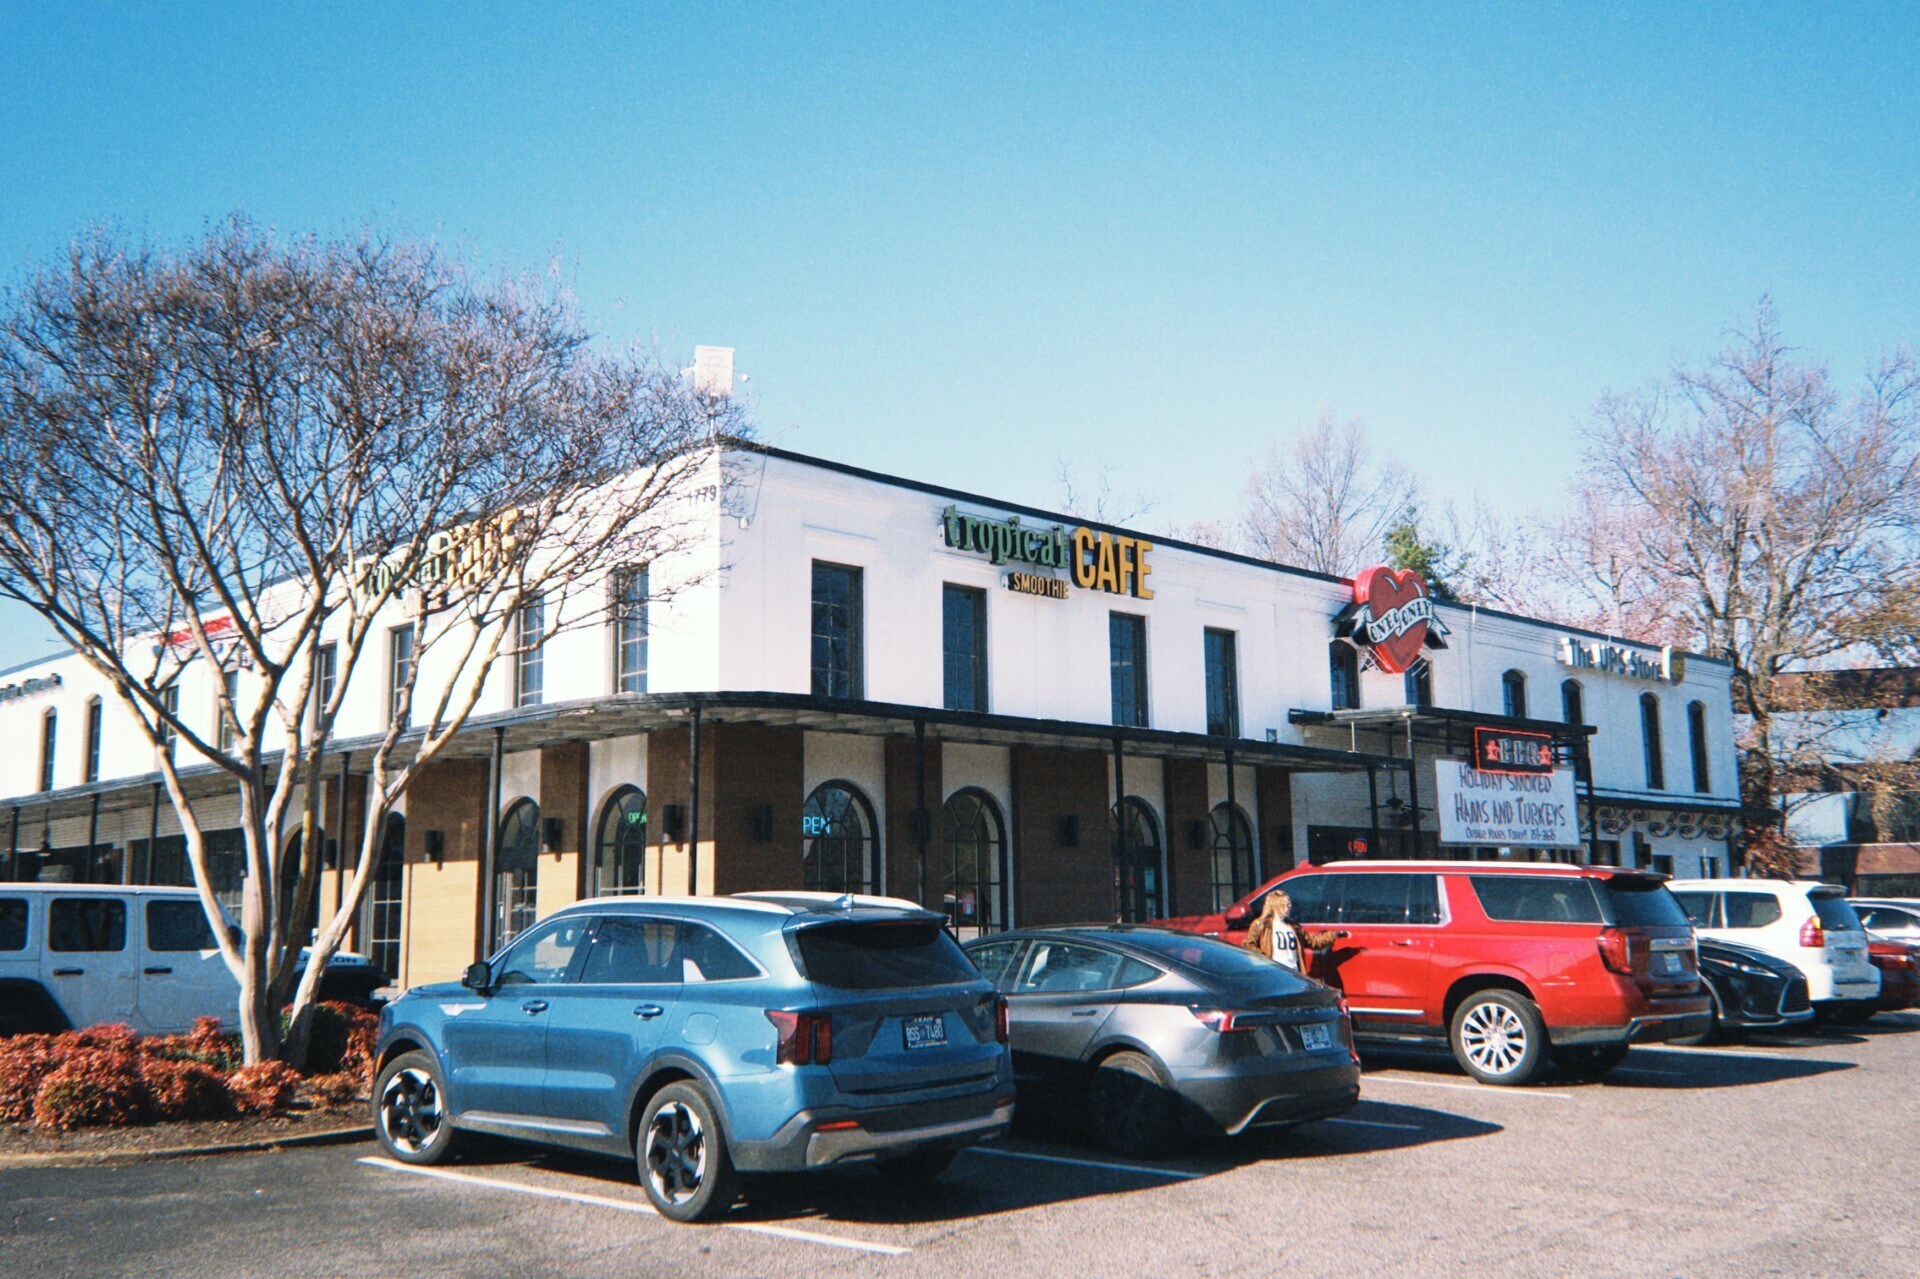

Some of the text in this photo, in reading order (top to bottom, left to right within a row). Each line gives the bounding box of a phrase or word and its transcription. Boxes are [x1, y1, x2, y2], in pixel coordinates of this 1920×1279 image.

[943, 504, 1154, 600] tropical CAFE
[1009, 571, 1070, 600] SMOOTHIE
[1370, 613, 1394, 642] ONE
[1402, 600, 1431, 626] ONLY
[1560, 637, 1595, 669] The
[1591, 643, 1626, 675] UPS
[1498, 738, 1542, 766] BBQ
[1459, 765, 1552, 793] HOLIDAY SMOKED
[628, 812, 647, 824] OPN
[1454, 792, 1566, 827] HAMS AND TURKEYS
[802, 816, 831, 835] PEN
